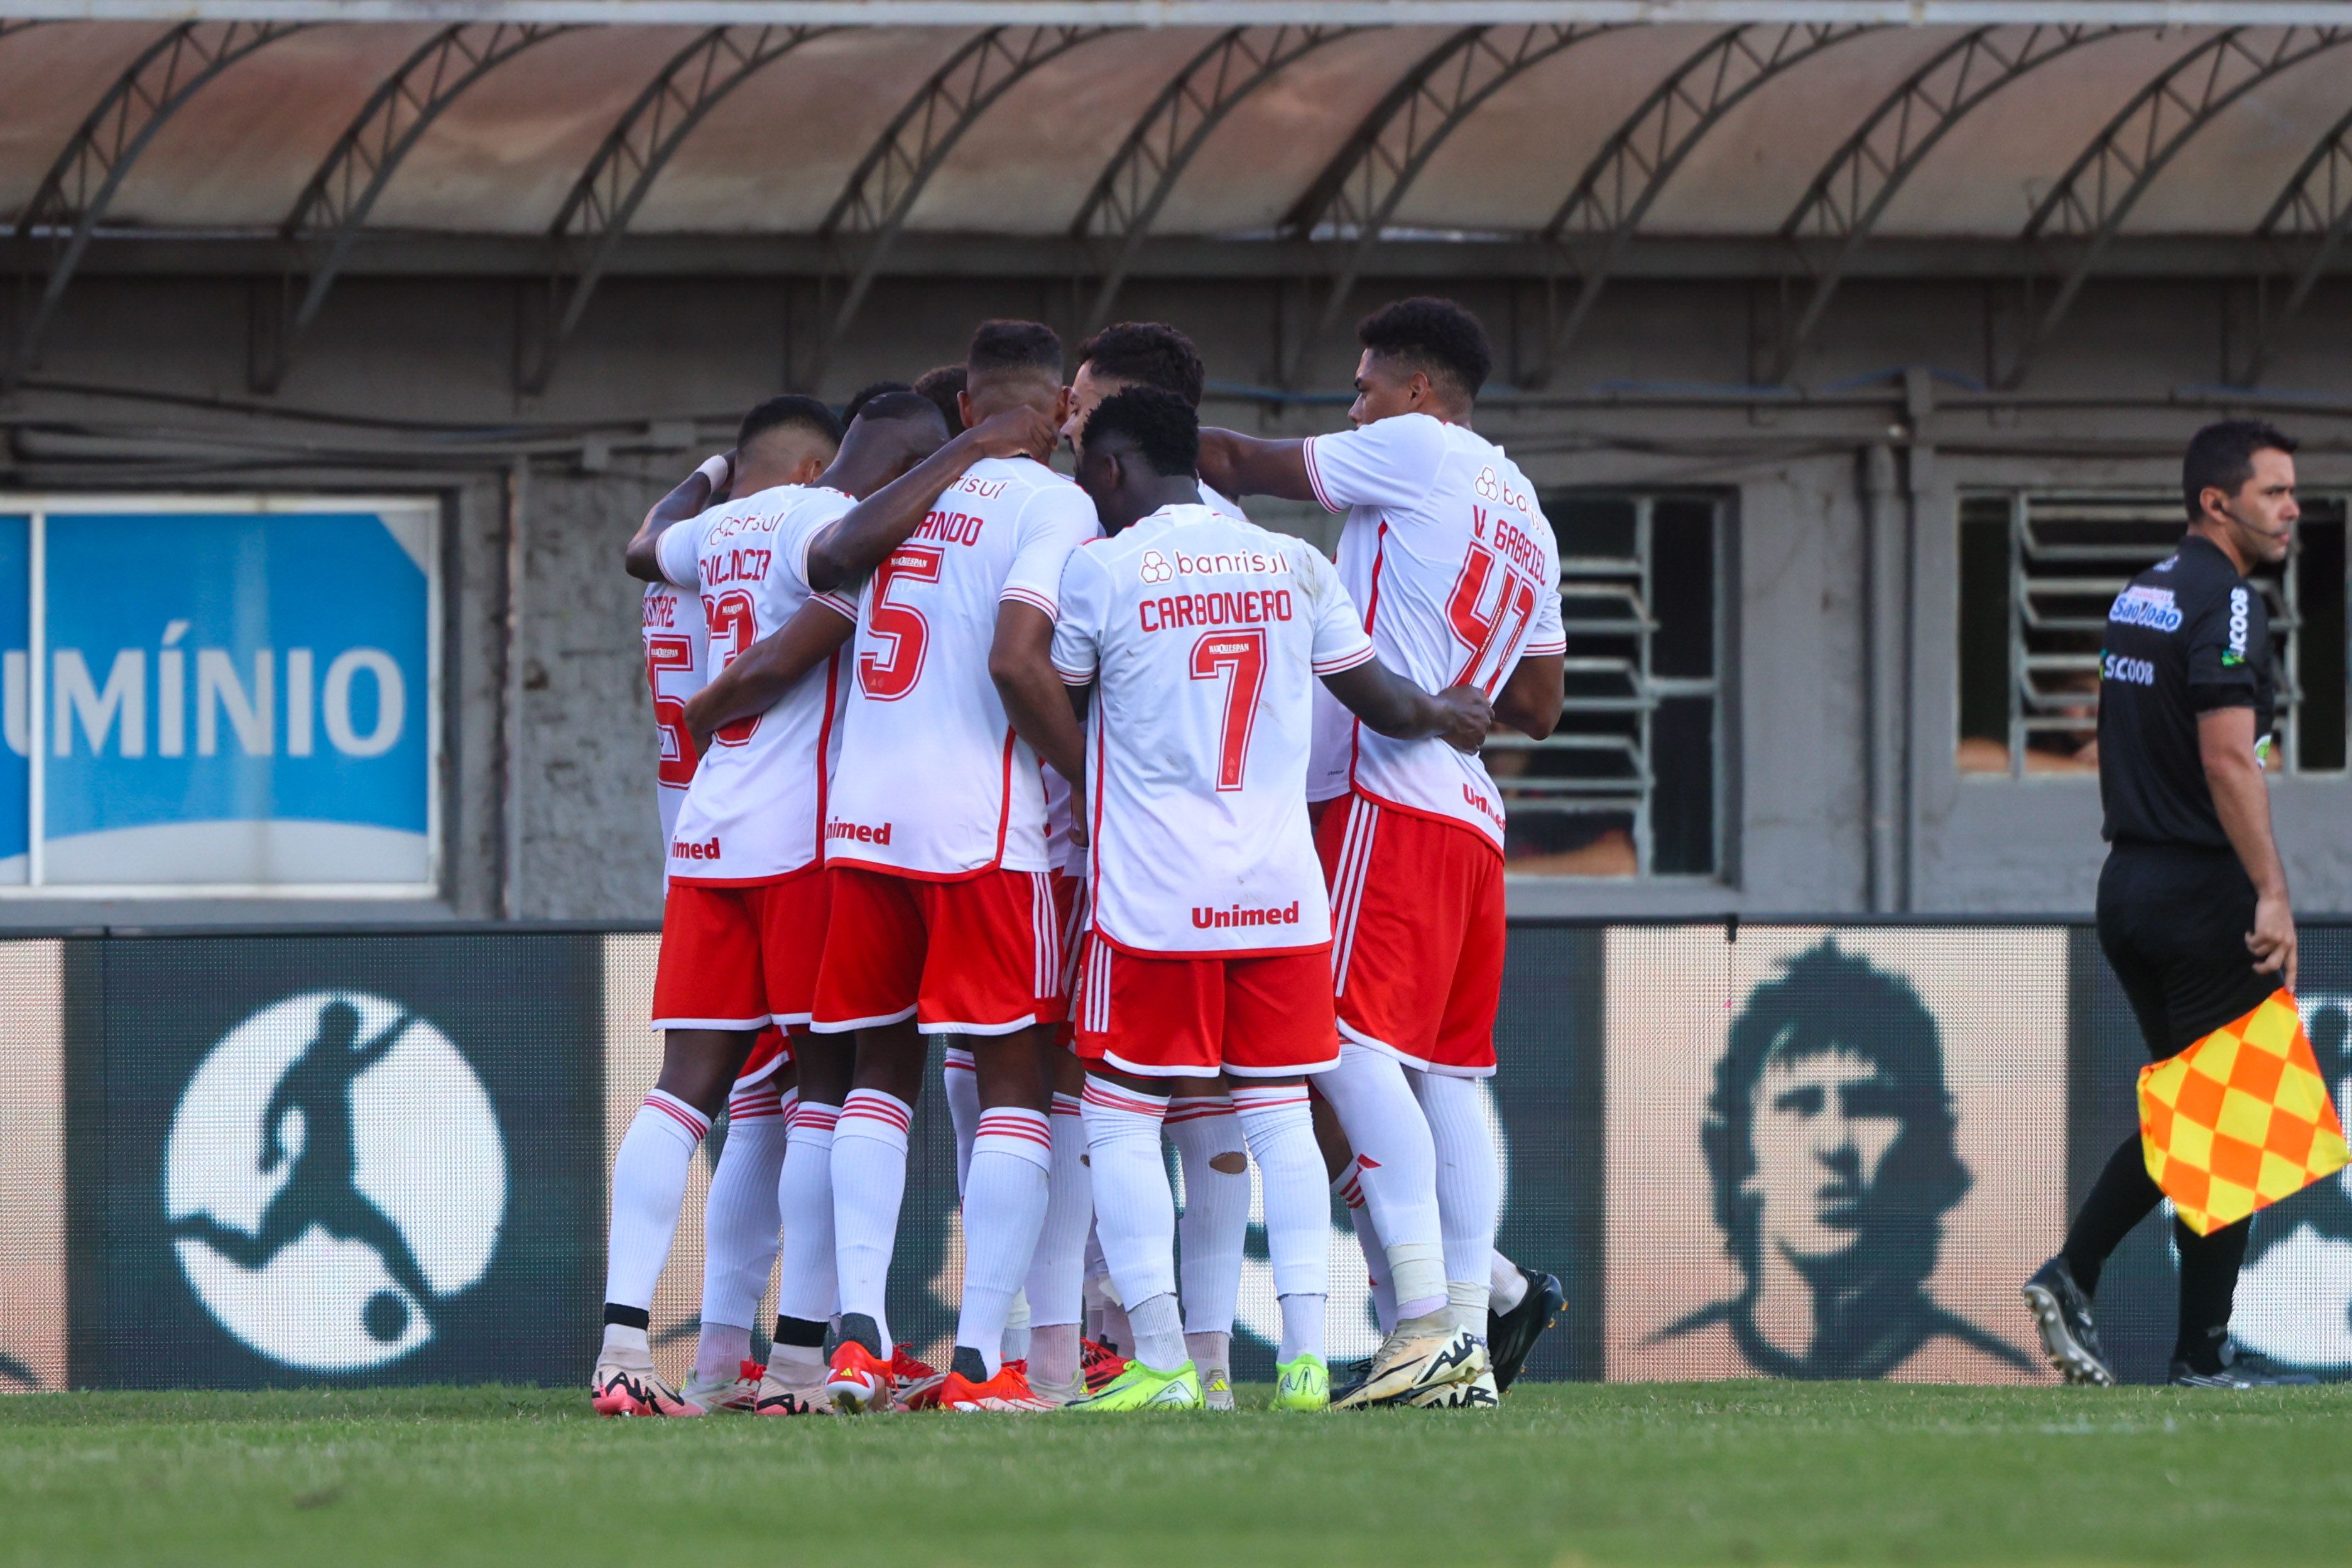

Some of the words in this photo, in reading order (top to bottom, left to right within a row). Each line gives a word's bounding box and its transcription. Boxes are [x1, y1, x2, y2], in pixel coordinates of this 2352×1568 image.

[912, 511, 984, 547] ANDO
[1176, 551, 1288, 575] banrisul
[1494, 519, 1546, 587] GABRIEL
[857, 544, 945, 702] 5
[1139, 589, 1292, 633] CARBONERO
[1208, 643, 1250, 654] MARQUESPAN
[1189, 628, 1268, 792] 7
[1192, 901, 1299, 928] Unimed
